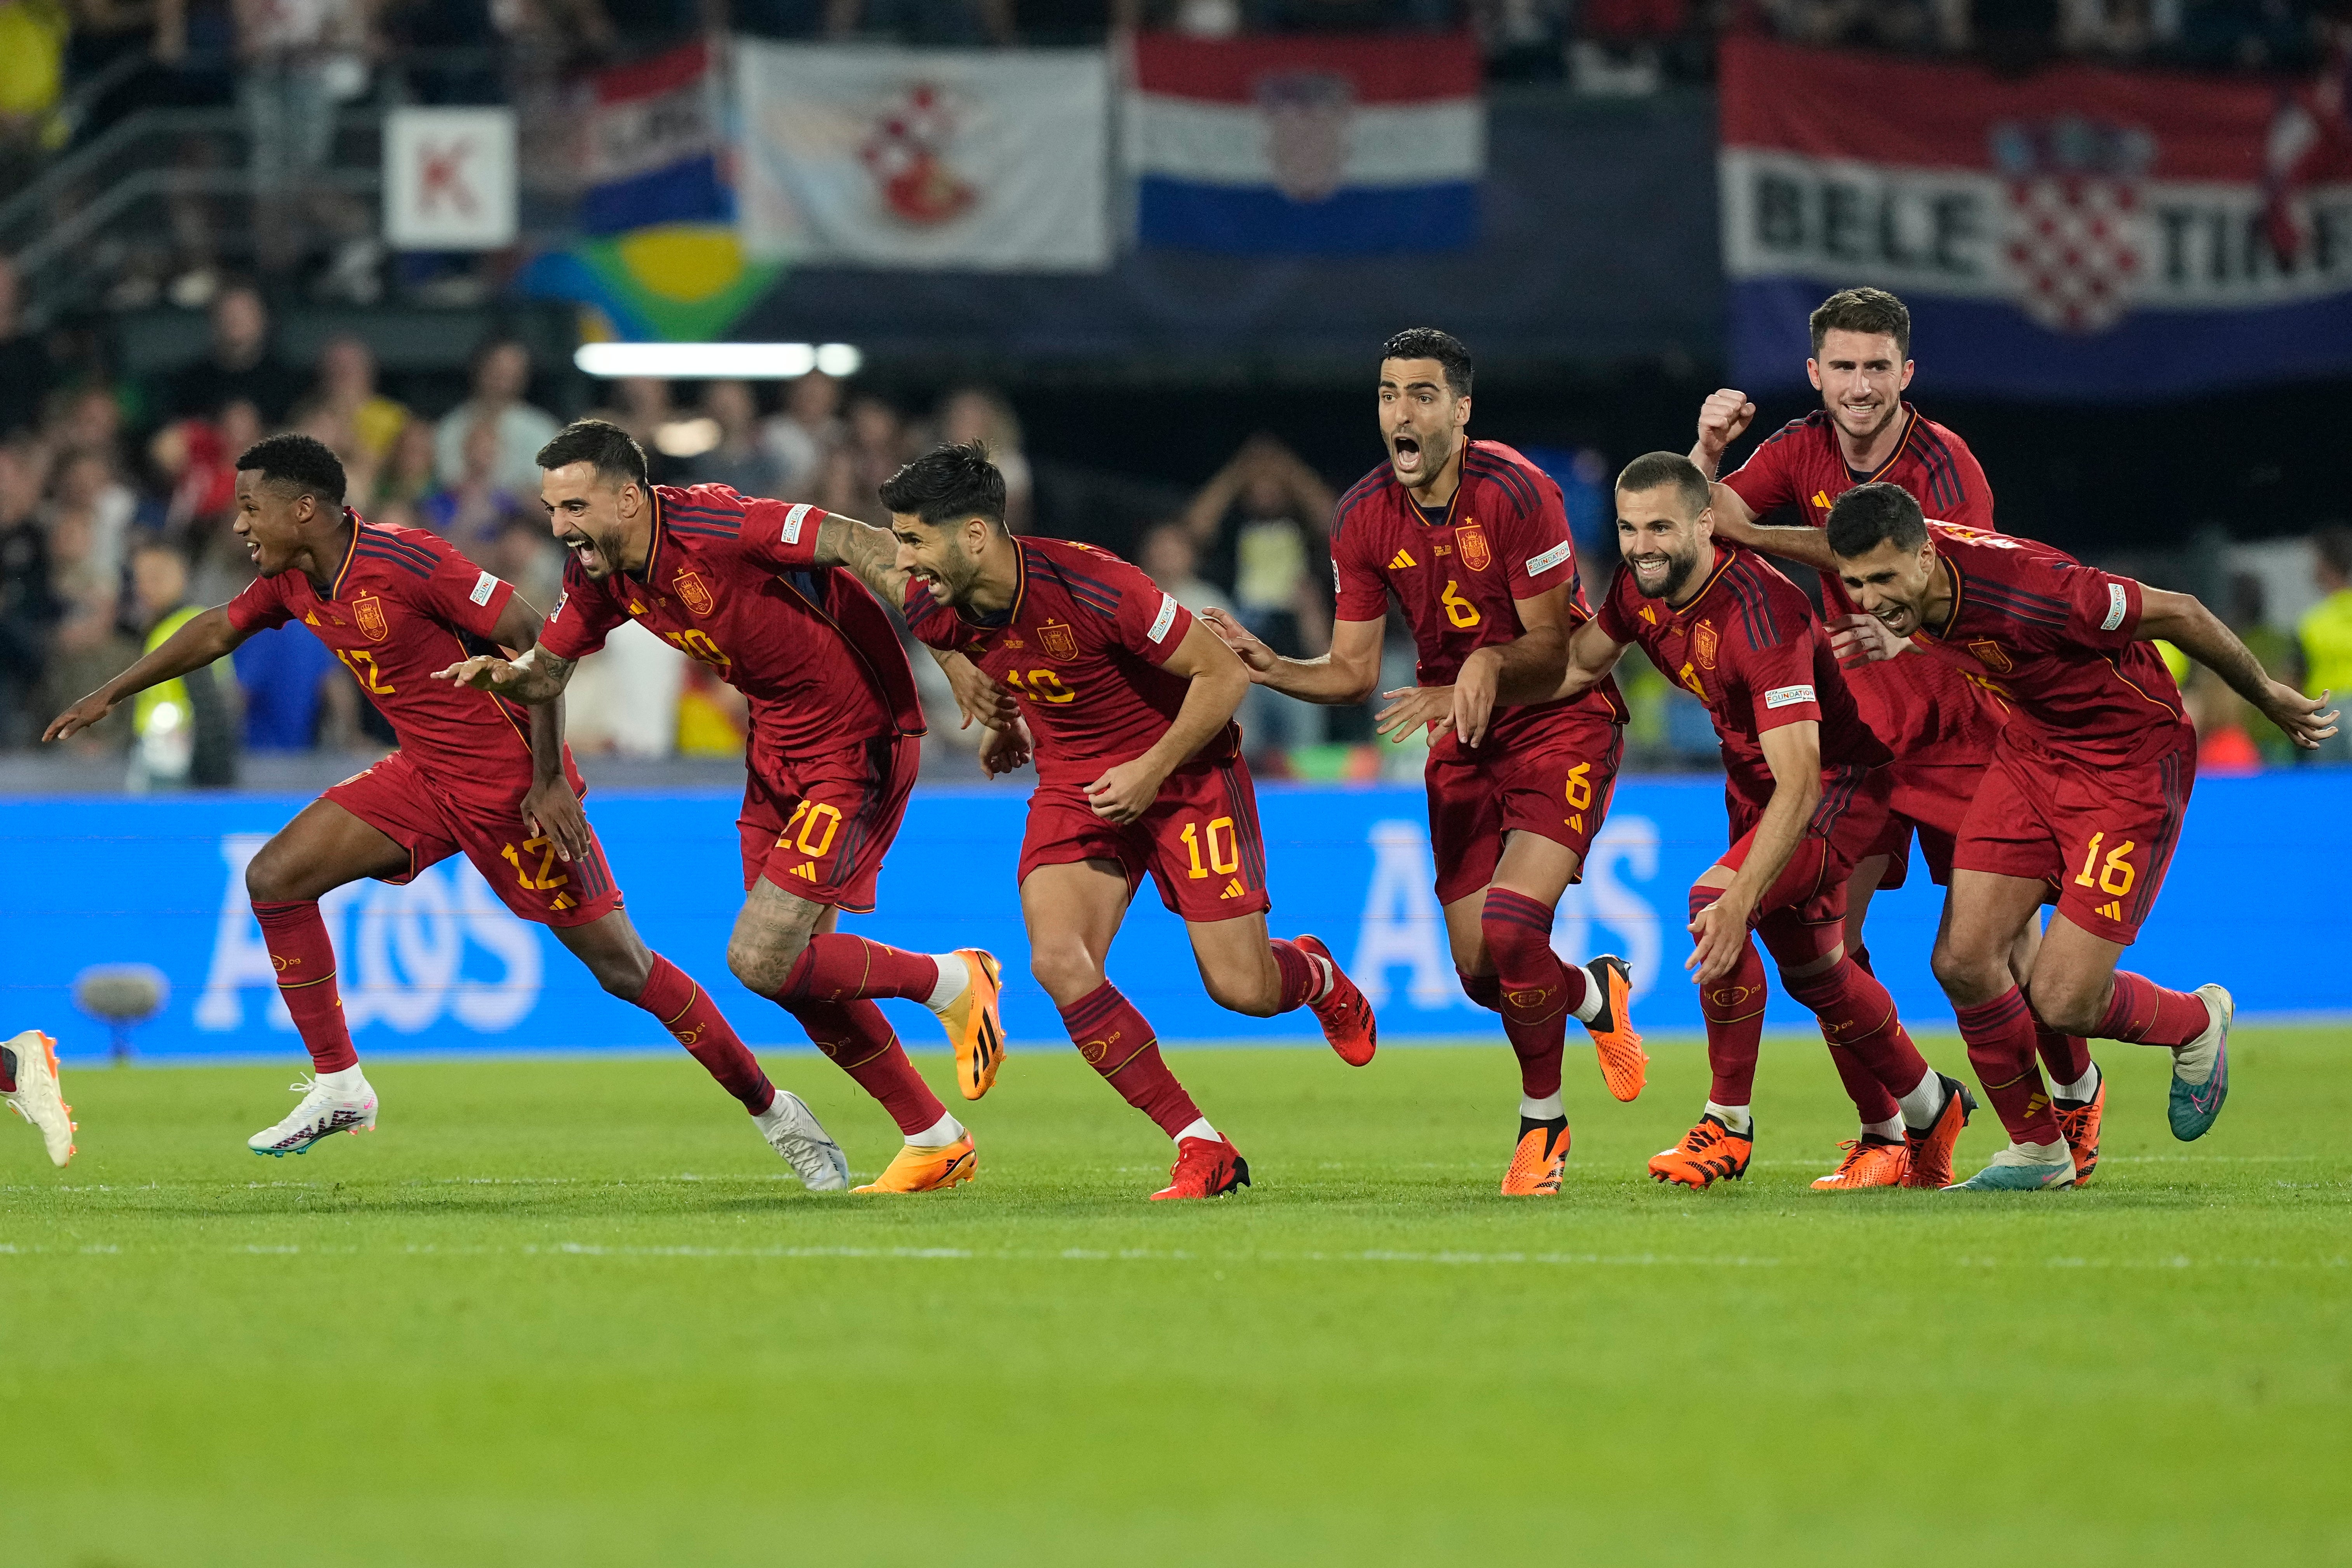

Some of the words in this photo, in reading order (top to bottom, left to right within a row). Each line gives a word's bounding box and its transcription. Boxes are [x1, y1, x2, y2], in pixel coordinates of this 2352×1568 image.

[414, 134, 482, 218] K
[1757, 172, 1983, 277] BELE
[787, 506, 804, 541] FOUNDATIO
[1529, 546, 1568, 571] FOUNDATION
[1152, 597, 1172, 640] FOUNDATION
[1441, 580, 1480, 628] 6
[336, 649, 396, 695] 12
[1007, 669, 1076, 703] 10
[1767, 690, 1814, 703] FOUNDATION
[1566, 761, 1591, 811] 6
[775, 800, 842, 858] 20
[1179, 816, 1239, 879] 10
[501, 835, 568, 890] 12
[2074, 832, 2135, 896] 16
